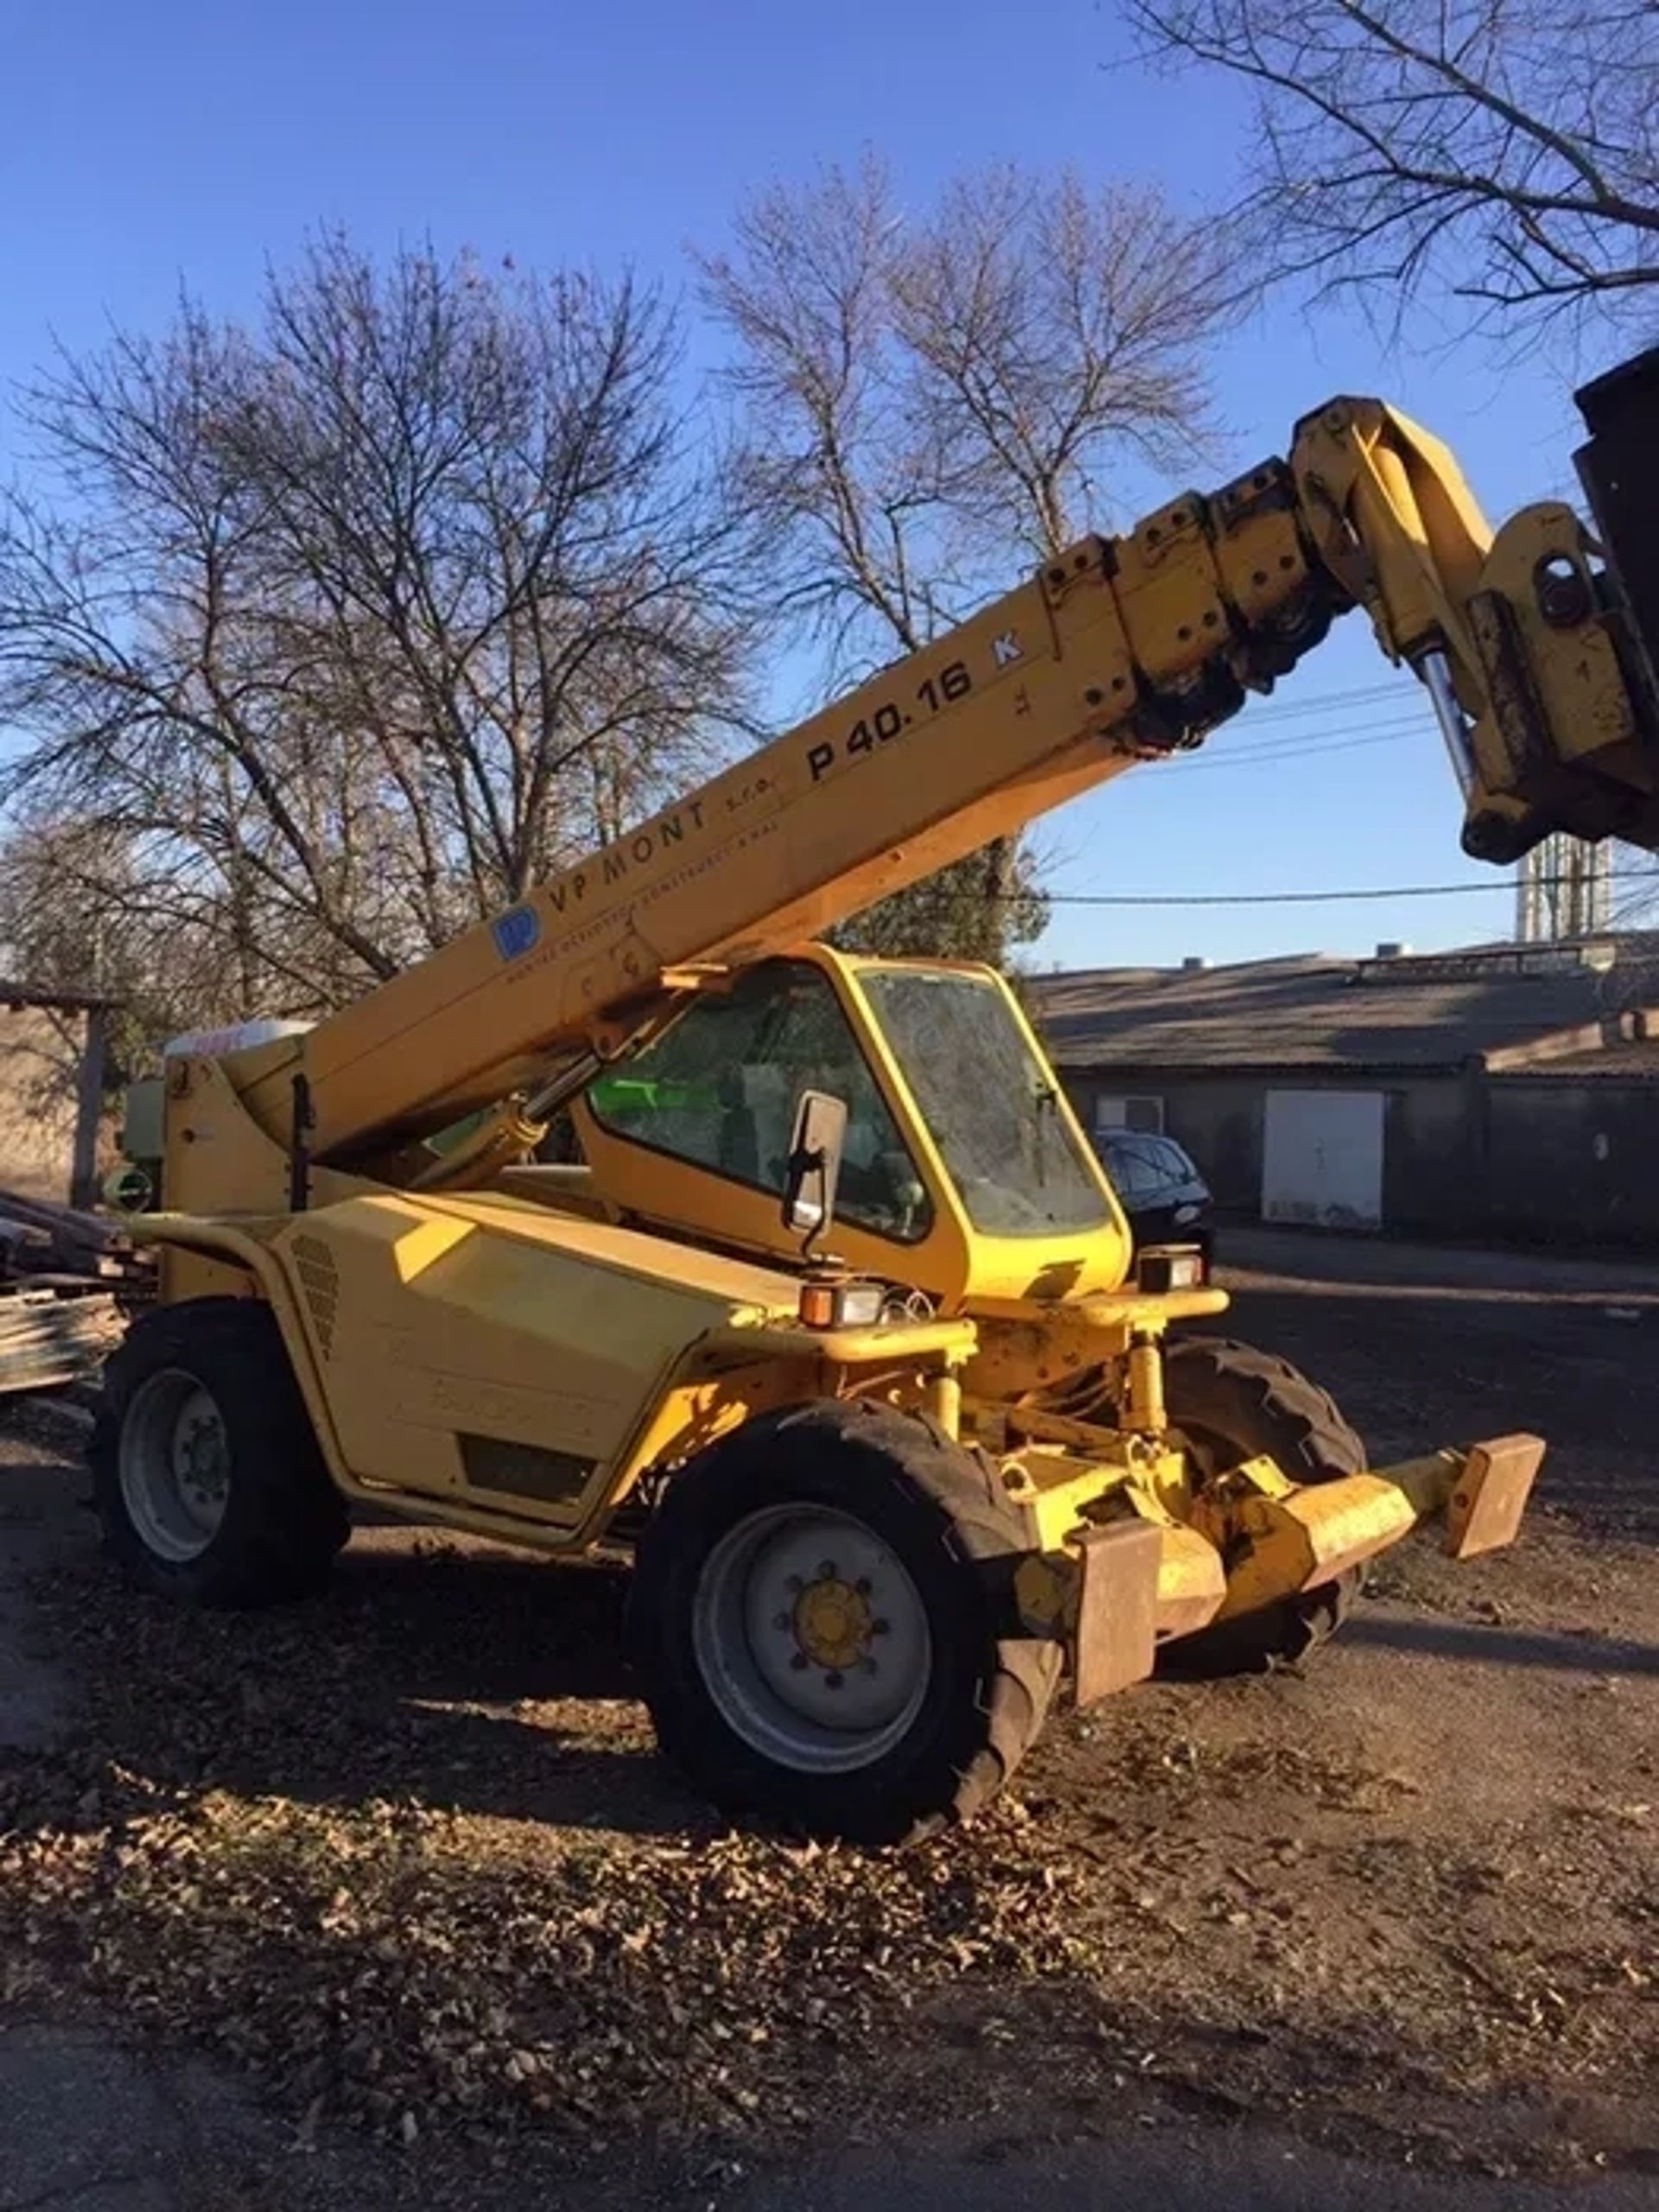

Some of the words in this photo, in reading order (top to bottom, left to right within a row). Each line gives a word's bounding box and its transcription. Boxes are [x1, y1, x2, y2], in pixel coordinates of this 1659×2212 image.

[806, 741, 835, 781] P
[846, 660, 972, 754] 40.16
[992, 630, 1025, 668] K
[549, 874, 586, 912] VP
[604, 801, 705, 885] MONT
